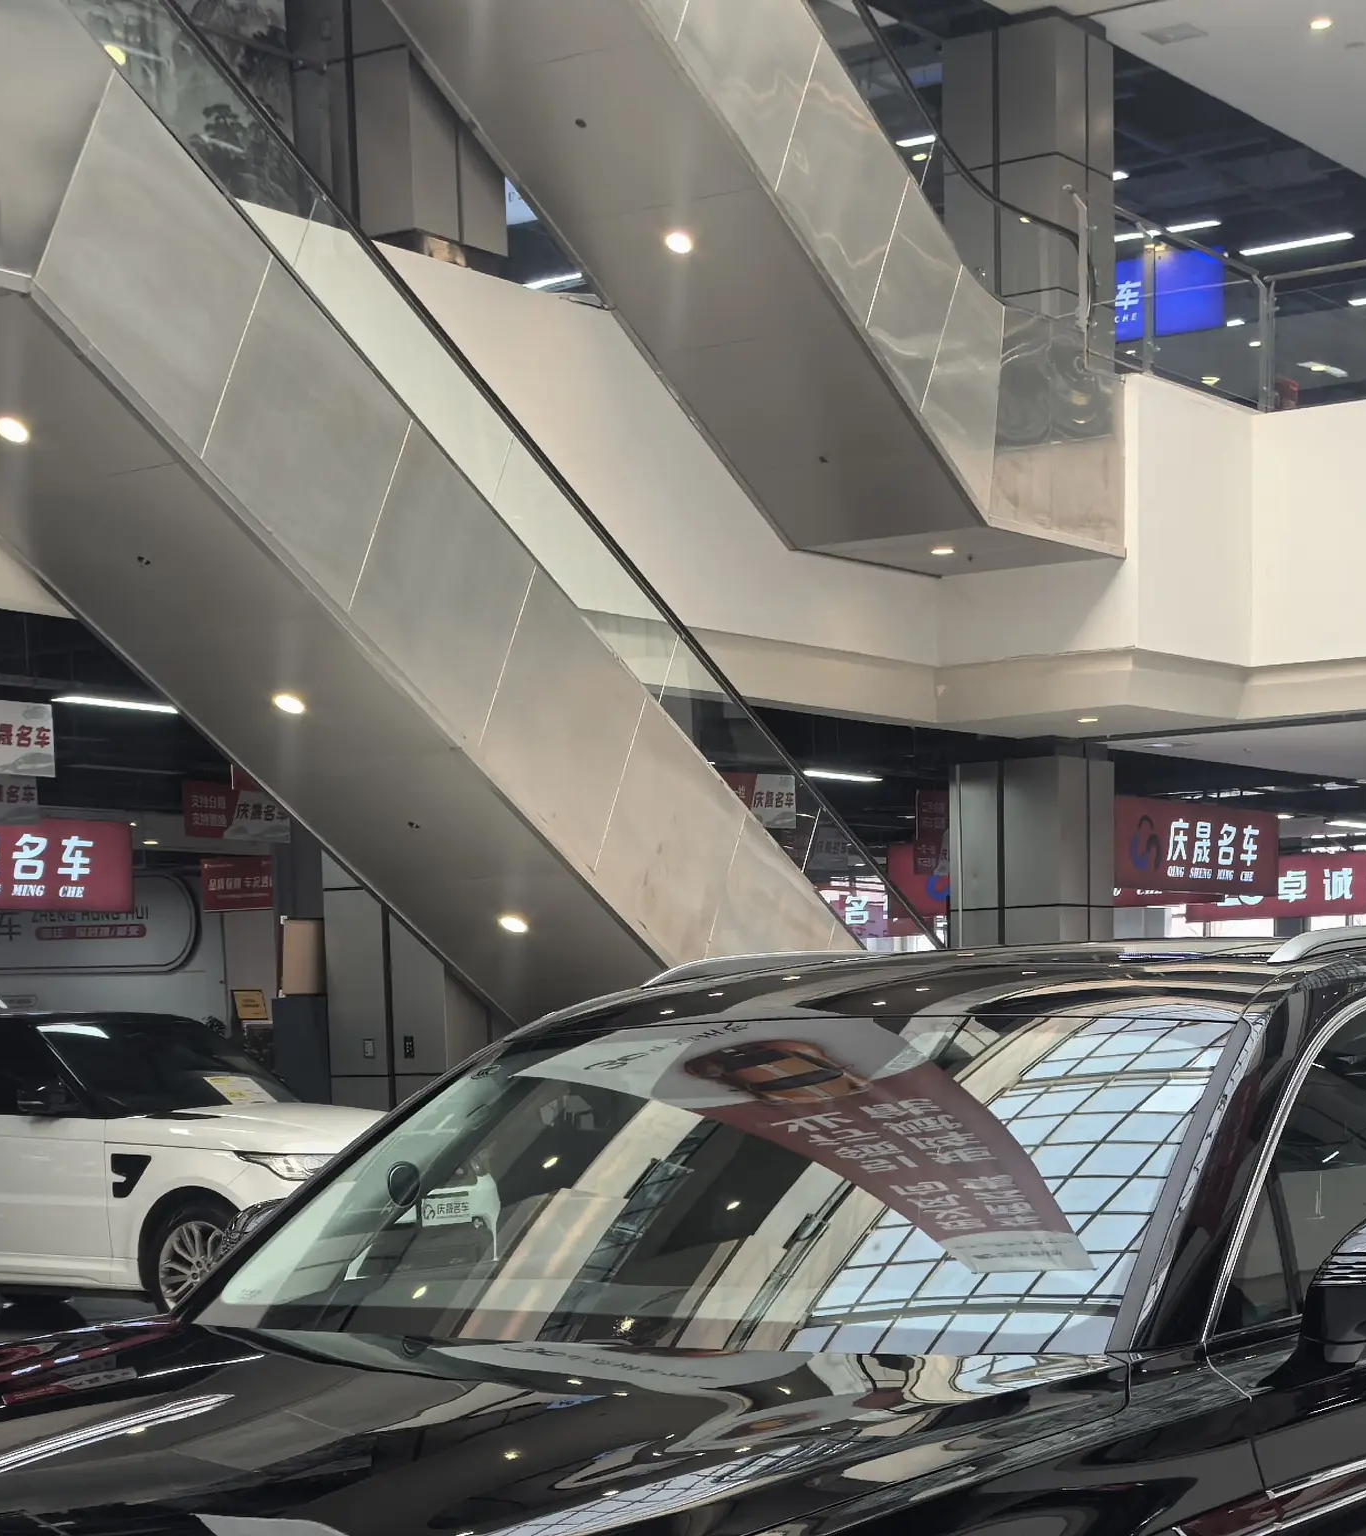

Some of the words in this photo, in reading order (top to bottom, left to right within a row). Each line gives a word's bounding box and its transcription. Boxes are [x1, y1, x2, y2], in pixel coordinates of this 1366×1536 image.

[1115, 281, 1141, 310] 车
[1167, 818, 1260, 866] 庆晟名车
[1167, 865, 1185, 878] QING
[1189, 866, 1212, 879] SHENG
[1217, 868, 1234, 881] MING
[1240, 870, 1255, 882] CHE
[12, 883, 45, 897] MING
[58, 885, 84, 898] CHE
